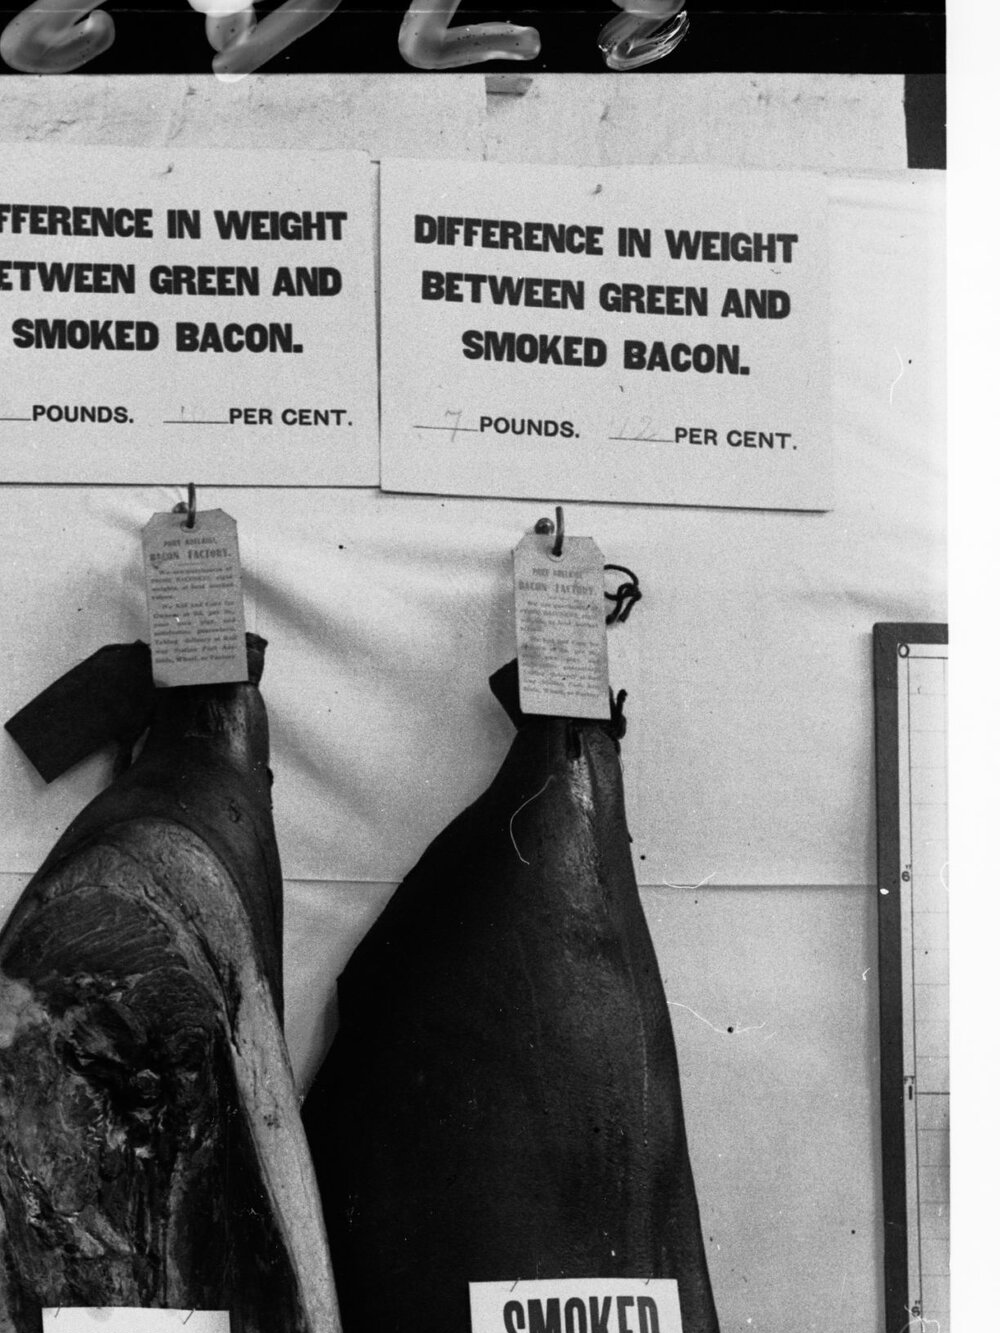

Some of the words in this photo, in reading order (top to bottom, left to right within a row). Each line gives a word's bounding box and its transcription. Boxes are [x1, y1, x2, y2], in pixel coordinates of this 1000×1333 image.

[167, 209, 201, 240] IN
[213, 210, 348, 241] WEIGHT
[414, 214, 604, 256] DIFFERENCE
[618, 227, 651, 258] IN
[664, 229, 799, 263] WEIGHT
[149, 264, 260, 297] GREEN
[272, 266, 343, 297] AND
[421, 270, 585, 311] BETWEEN
[599, 282, 708, 317] GREEN
[720, 288, 791, 320] AND
[11, 318, 160, 352] SMOKED
[175, 321, 304, 354] BACON.
[461, 329, 608, 368] SMOKED
[623, 339, 750, 376] BACON.
[32, 404, 134, 424] POUNDS.
[229, 407, 273, 425] PER
[281, 408, 353, 426] CENT.
[480, 416, 580, 439] POUNDS.
[675, 427, 718, 446] PER
[726, 429, 797, 450] CENT.
